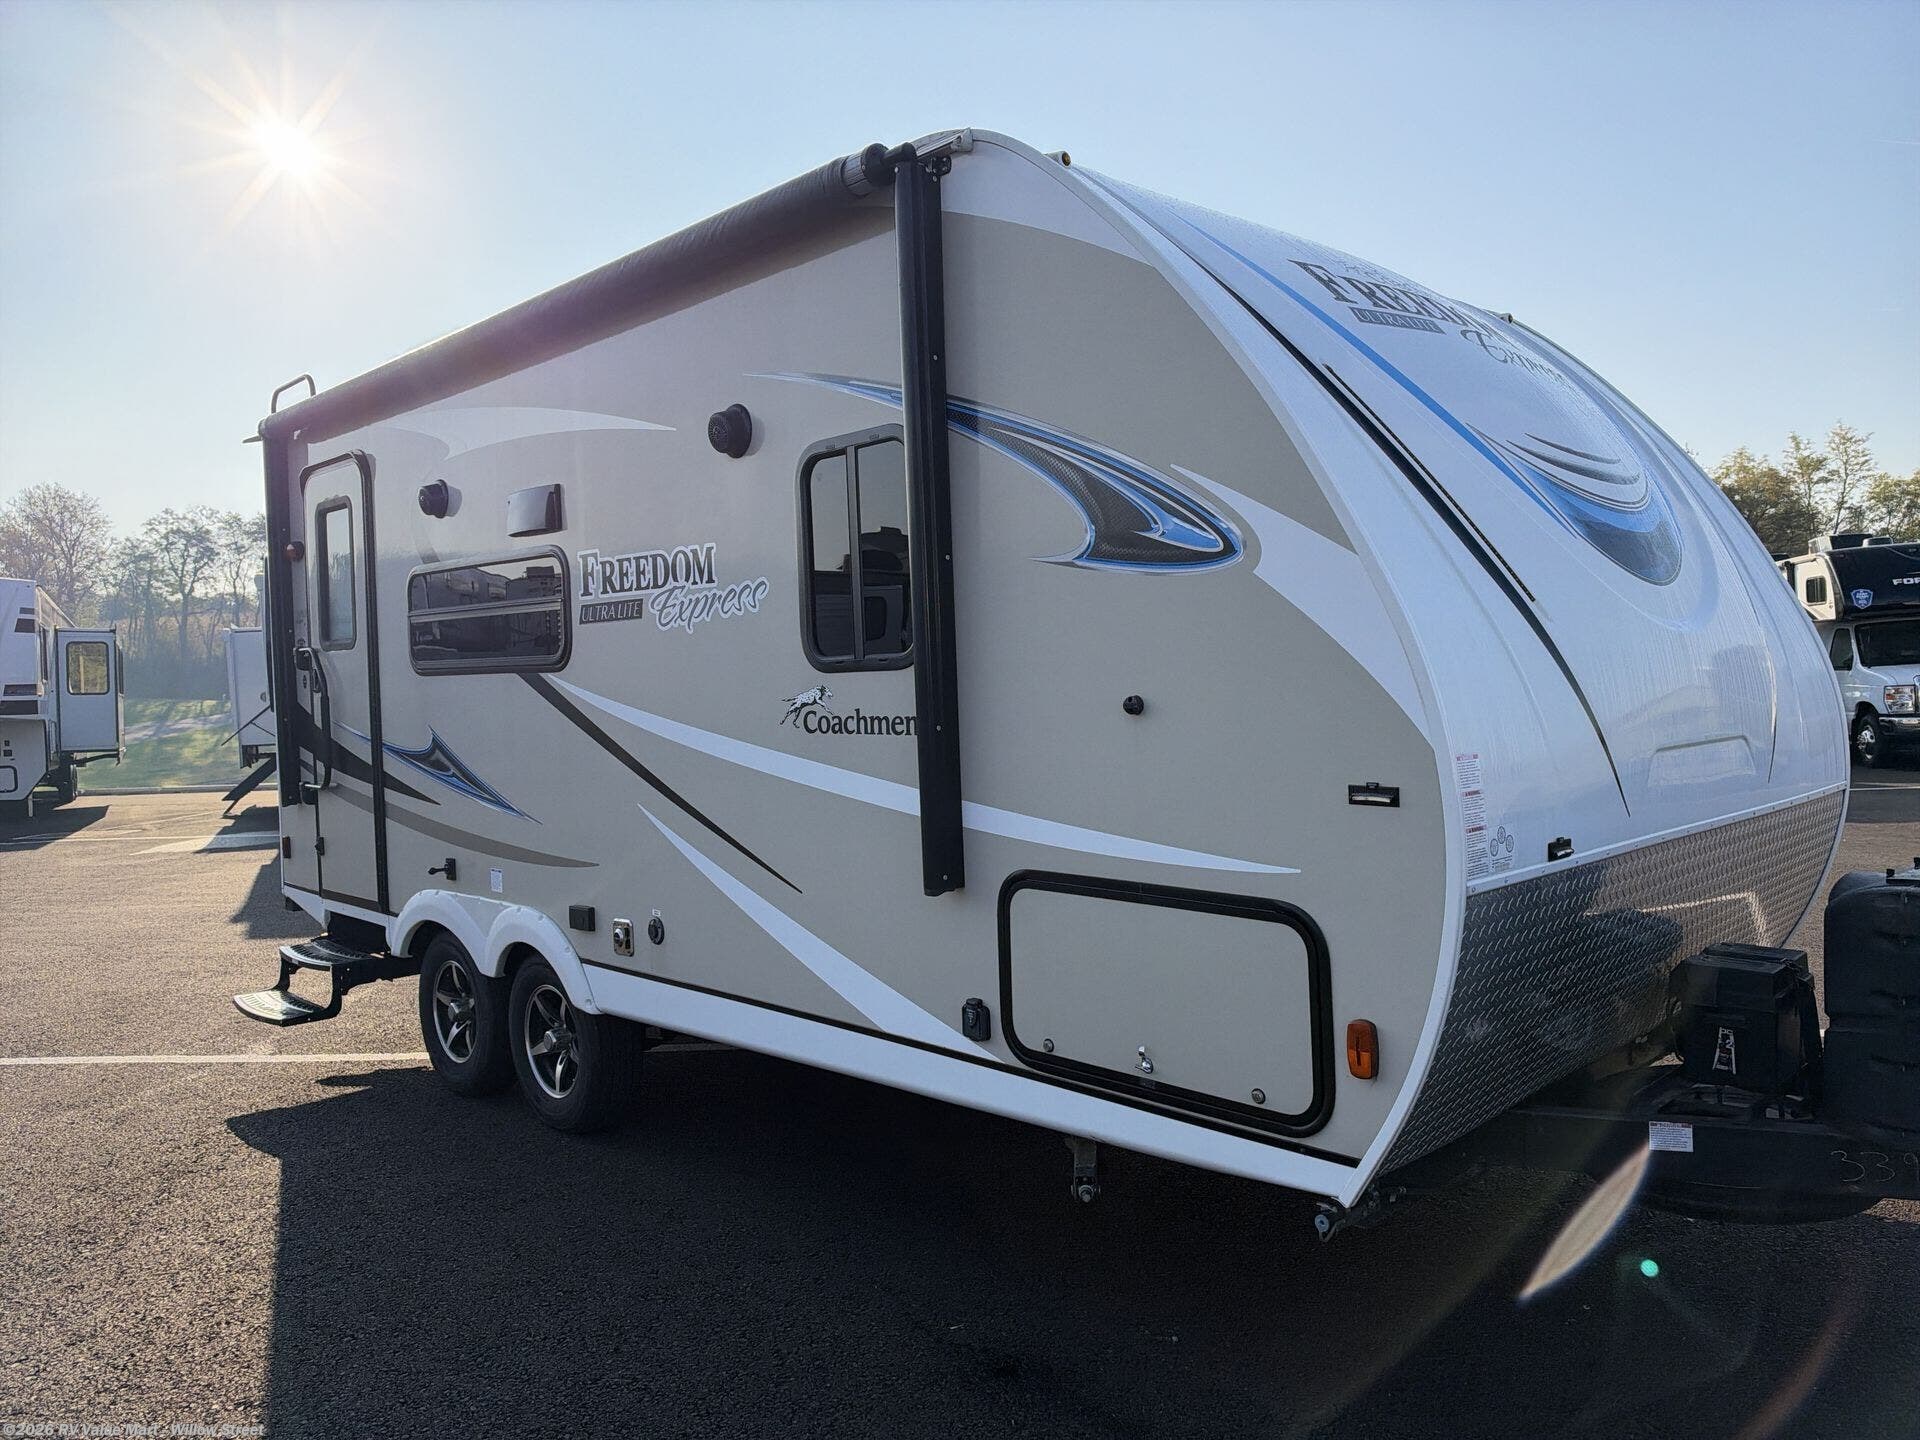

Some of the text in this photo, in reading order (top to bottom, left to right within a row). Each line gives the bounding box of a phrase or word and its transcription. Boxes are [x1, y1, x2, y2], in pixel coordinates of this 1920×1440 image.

[578, 545, 716, 598] FREEDOM
[650, 580, 768, 630] Express
[803, 708, 918, 736] Coachmen
